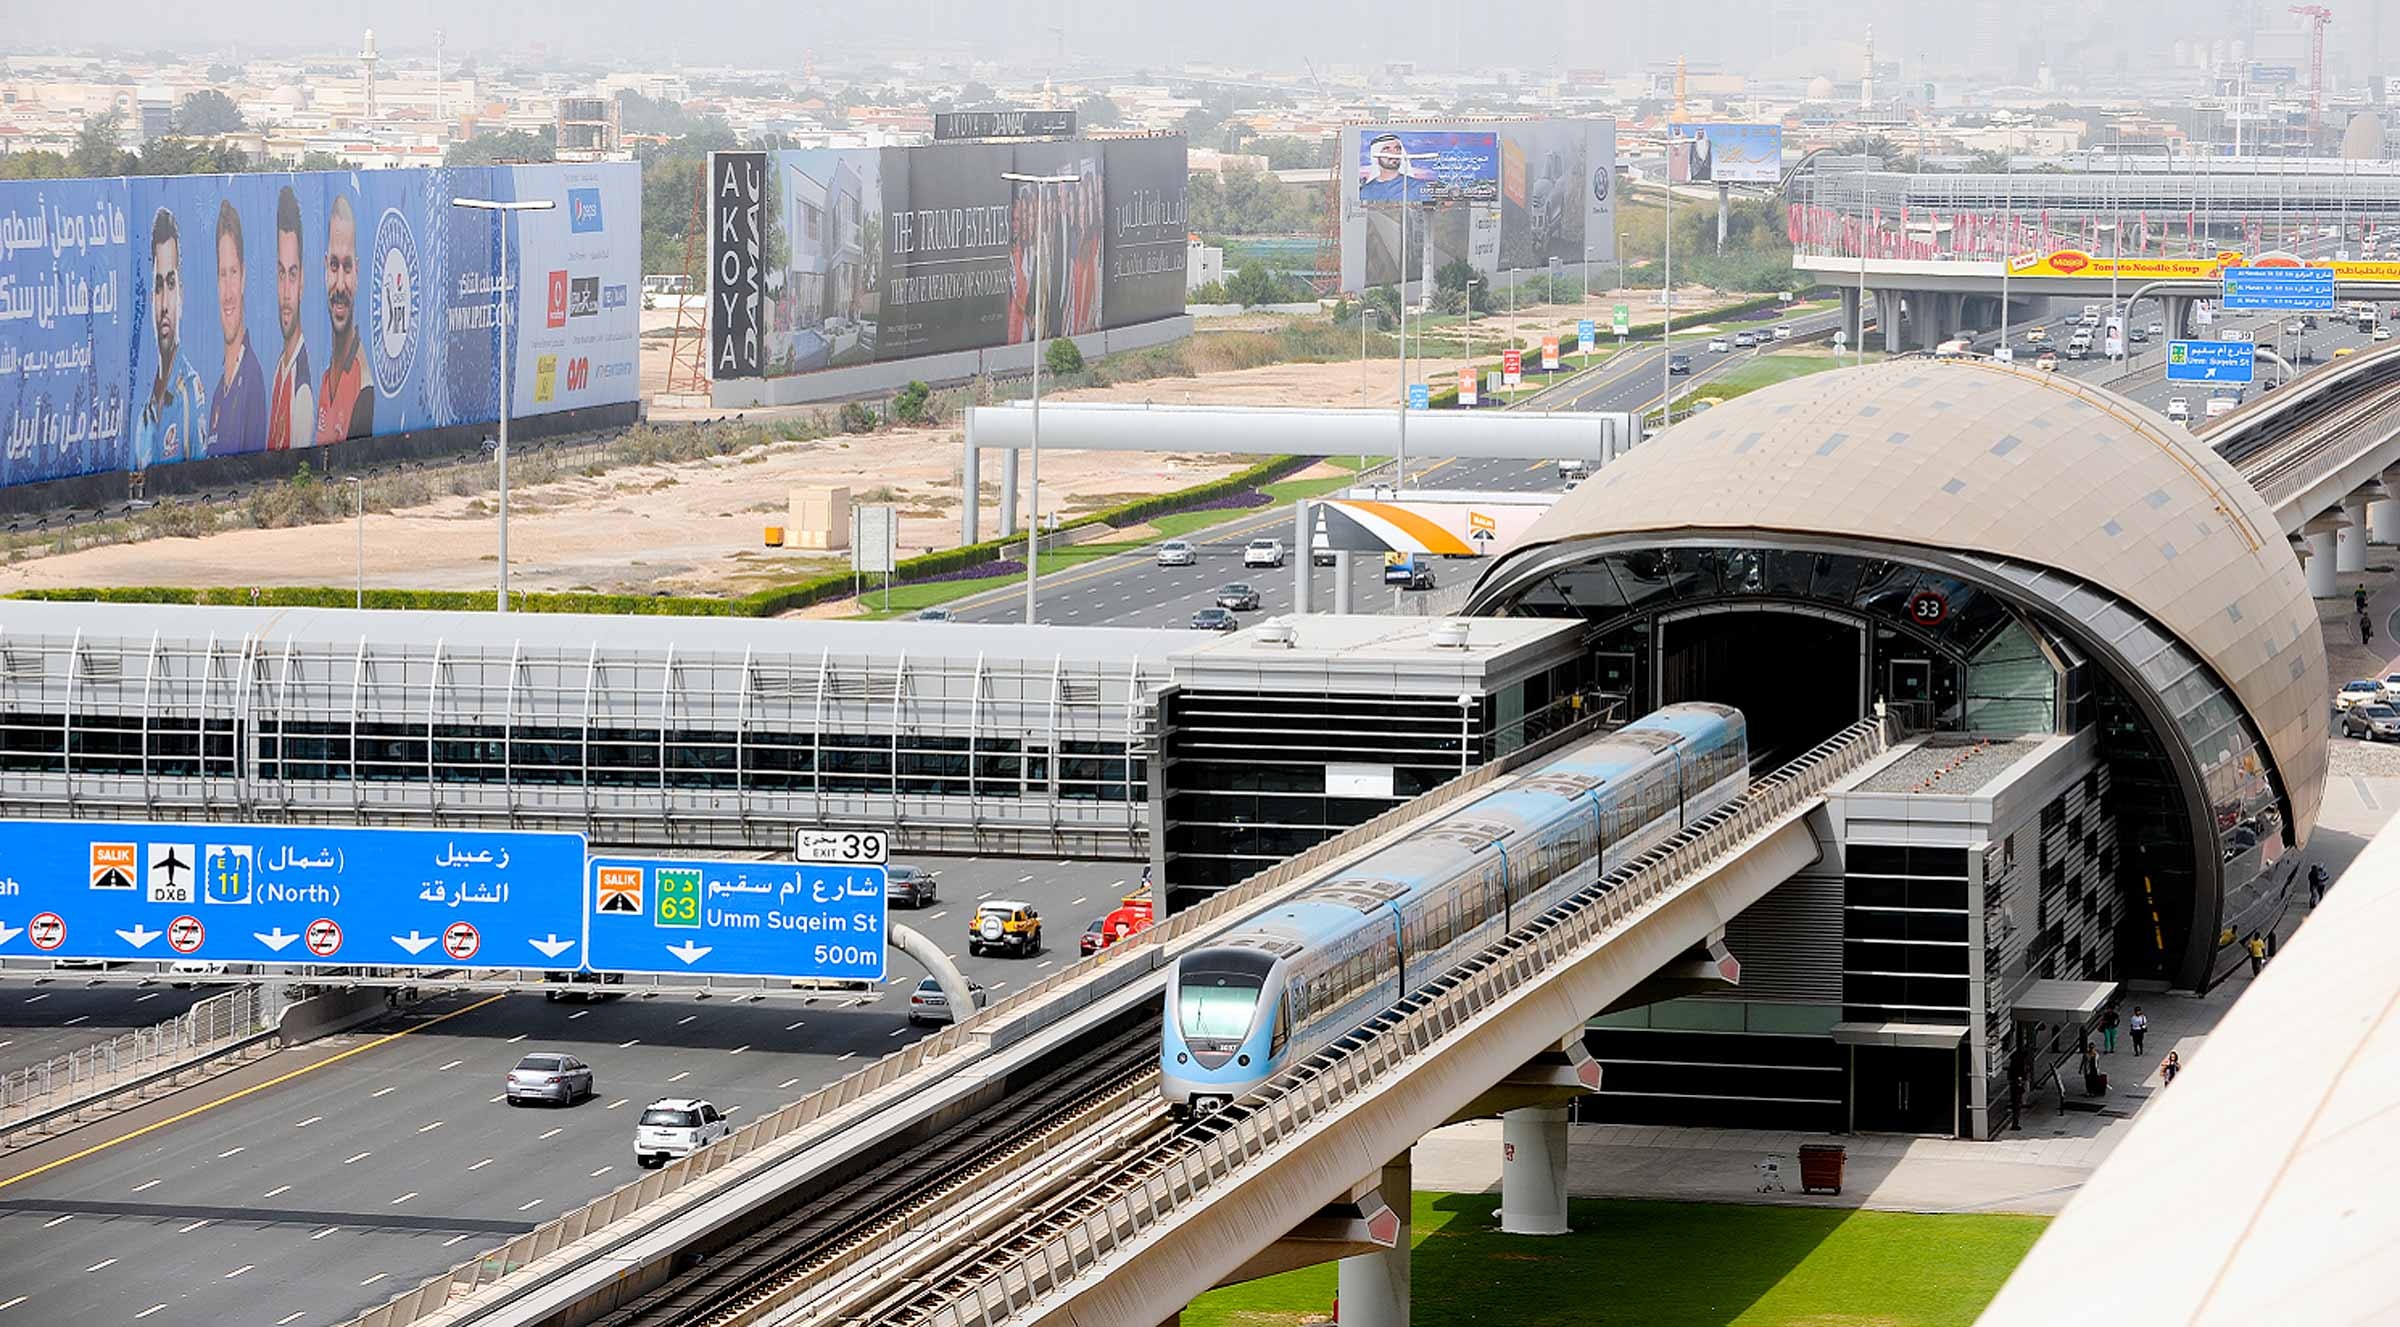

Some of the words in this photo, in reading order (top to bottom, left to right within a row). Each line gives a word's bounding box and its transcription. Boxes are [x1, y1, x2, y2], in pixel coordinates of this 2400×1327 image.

[0, 191, 48, 262] أسطو
[51, 205, 87, 259] وصل
[89, 201, 107, 246] قد
[108, 202, 126, 244] ها
[892, 211, 914, 254] THE
[918, 208, 963, 251] TRUMP
[965, 204, 1009, 248] ESTATES
[719, 161, 740, 370] AKOYA
[744, 159, 760, 369] DAMAC
[2134, 263, 2169, 272] Noodle
[2172, 264, 2200, 274] Soup
[38, 260, 59, 329] أين
[2217, 344, 2227, 357] أم
[2228, 346, 2252, 358] شارع
[7, 396, 41, 460] أبريل
[42, 412, 59, 445] 16
[60, 402, 87, 455] من
[1917, 600, 1940, 618] 33
[803, 835, 837, 847] مخرج
[813, 848, 837, 858] EXIT
[842, 834, 880, 859] 39
[96, 850, 130, 861] SALIK
[217, 858, 226, 870] E
[435, 841, 510, 869] زعبيل
[218, 873, 240, 895] 11
[604, 873, 637, 886] SALIK
[664, 879, 675, 892] D
[682, 879, 694, 893] د
[707, 874, 773, 900] سقيم
[778, 870, 802, 907] أم
[812, 876, 879, 903] شارع
[155, 888, 187, 902] DXB
[256, 883, 340, 907] (North)
[419, 879, 510, 908] الشارقة
[660, 896, 696, 920] 63
[707, 908, 760, 929] Umm
[767, 911, 847, 934] Suqeim
[853, 913, 878, 933] St
[814, 944, 878, 966] 500m
